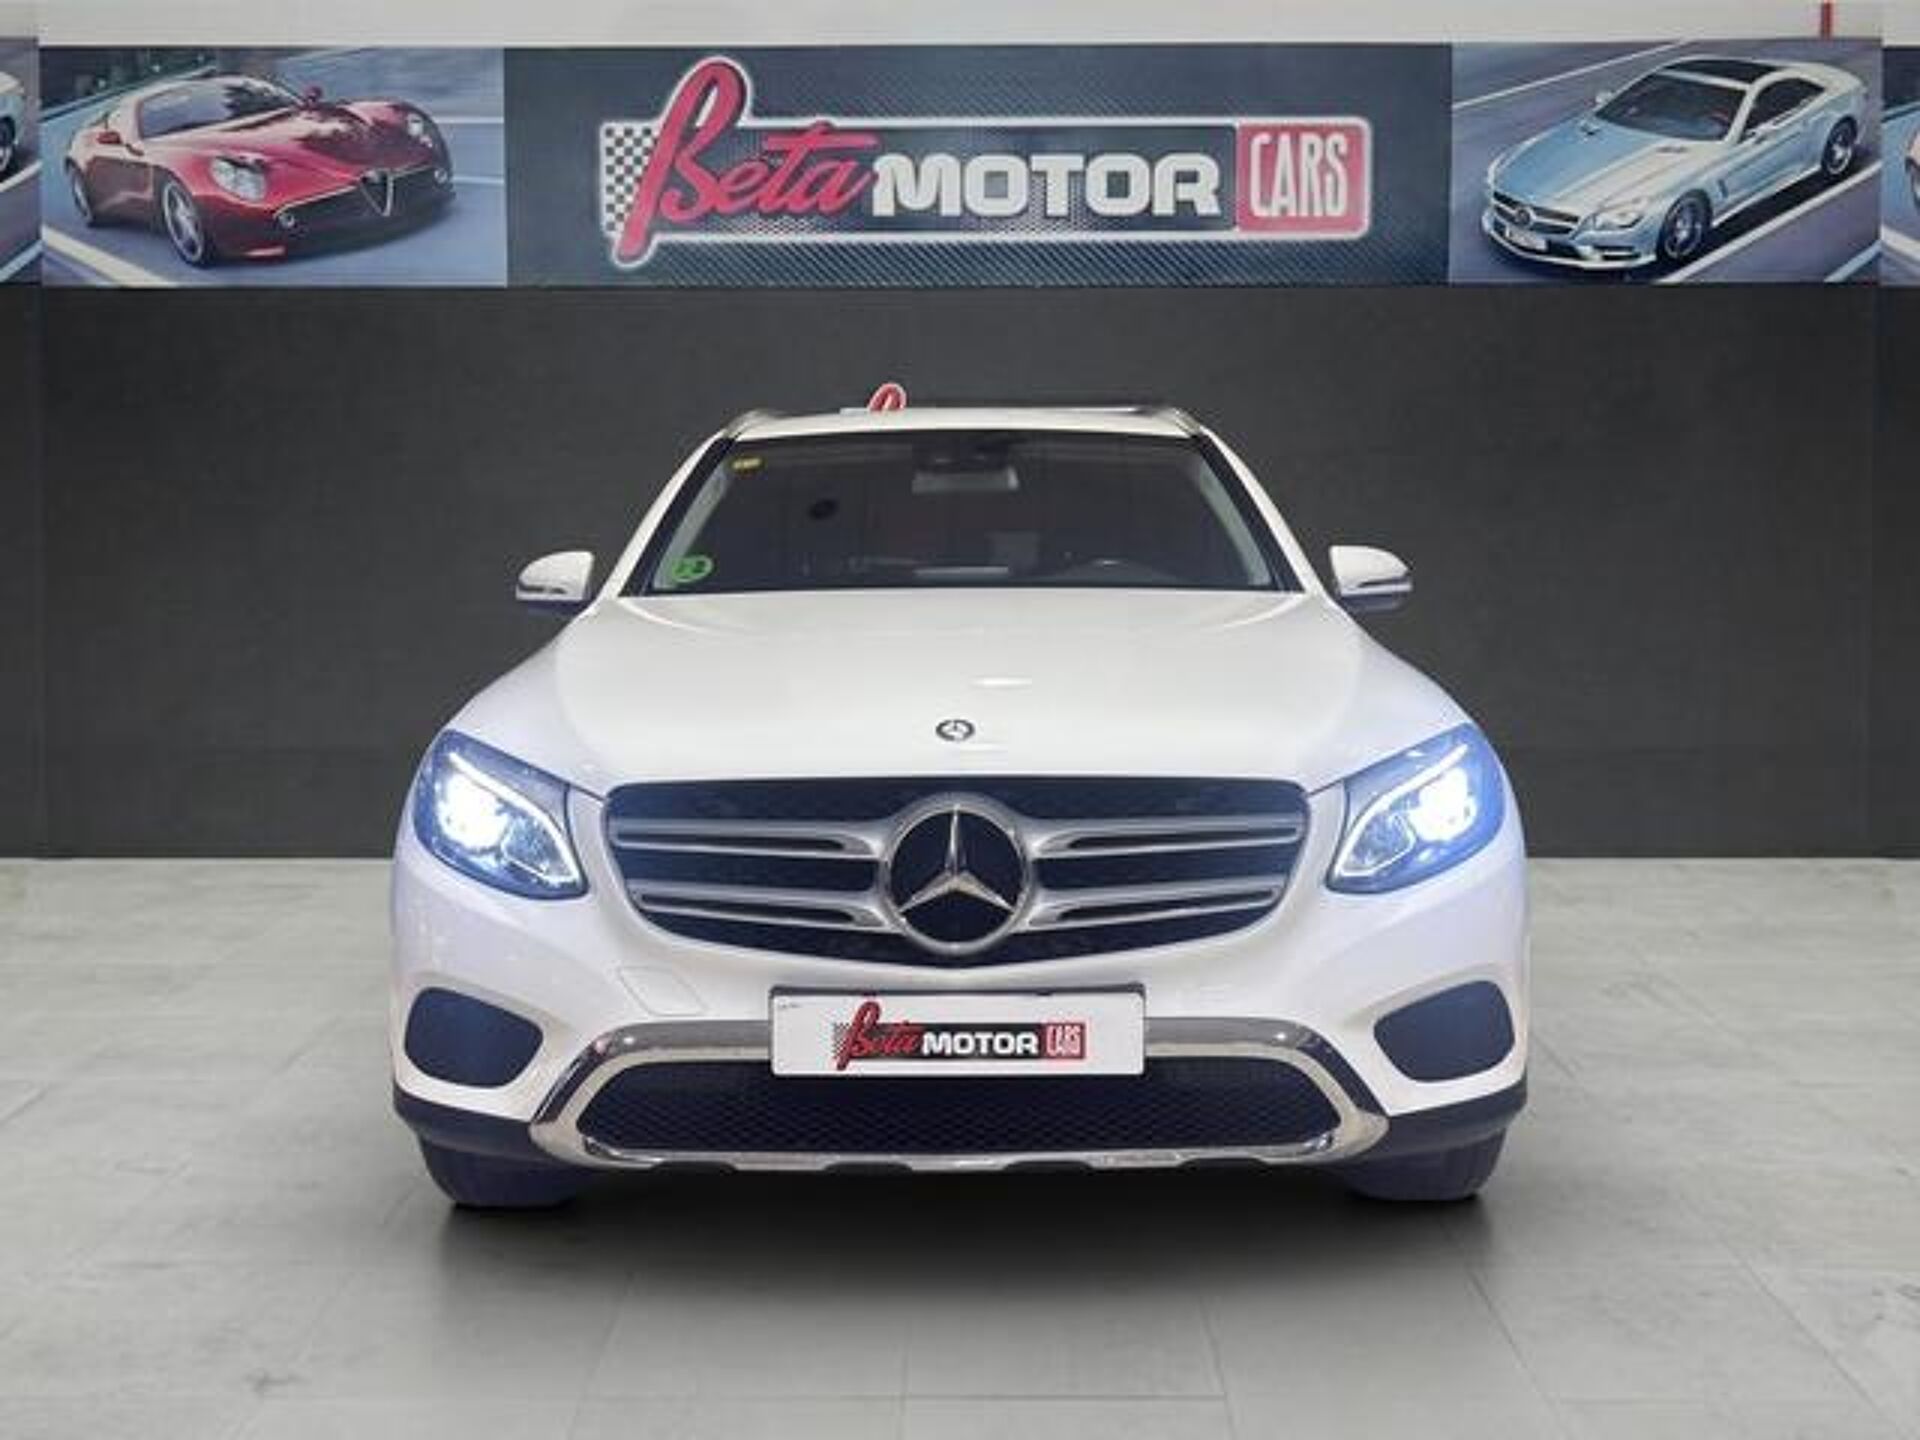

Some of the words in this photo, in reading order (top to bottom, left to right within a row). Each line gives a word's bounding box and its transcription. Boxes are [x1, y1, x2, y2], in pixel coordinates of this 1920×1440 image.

[617, 60, 882, 260] Beta
[873, 153, 1220, 217] MOTOR
[1250, 131, 1347, 218] CARS
[922, 1031, 1039, 1056] MOTOR
[1046, 1025, 1081, 1057] CARS
